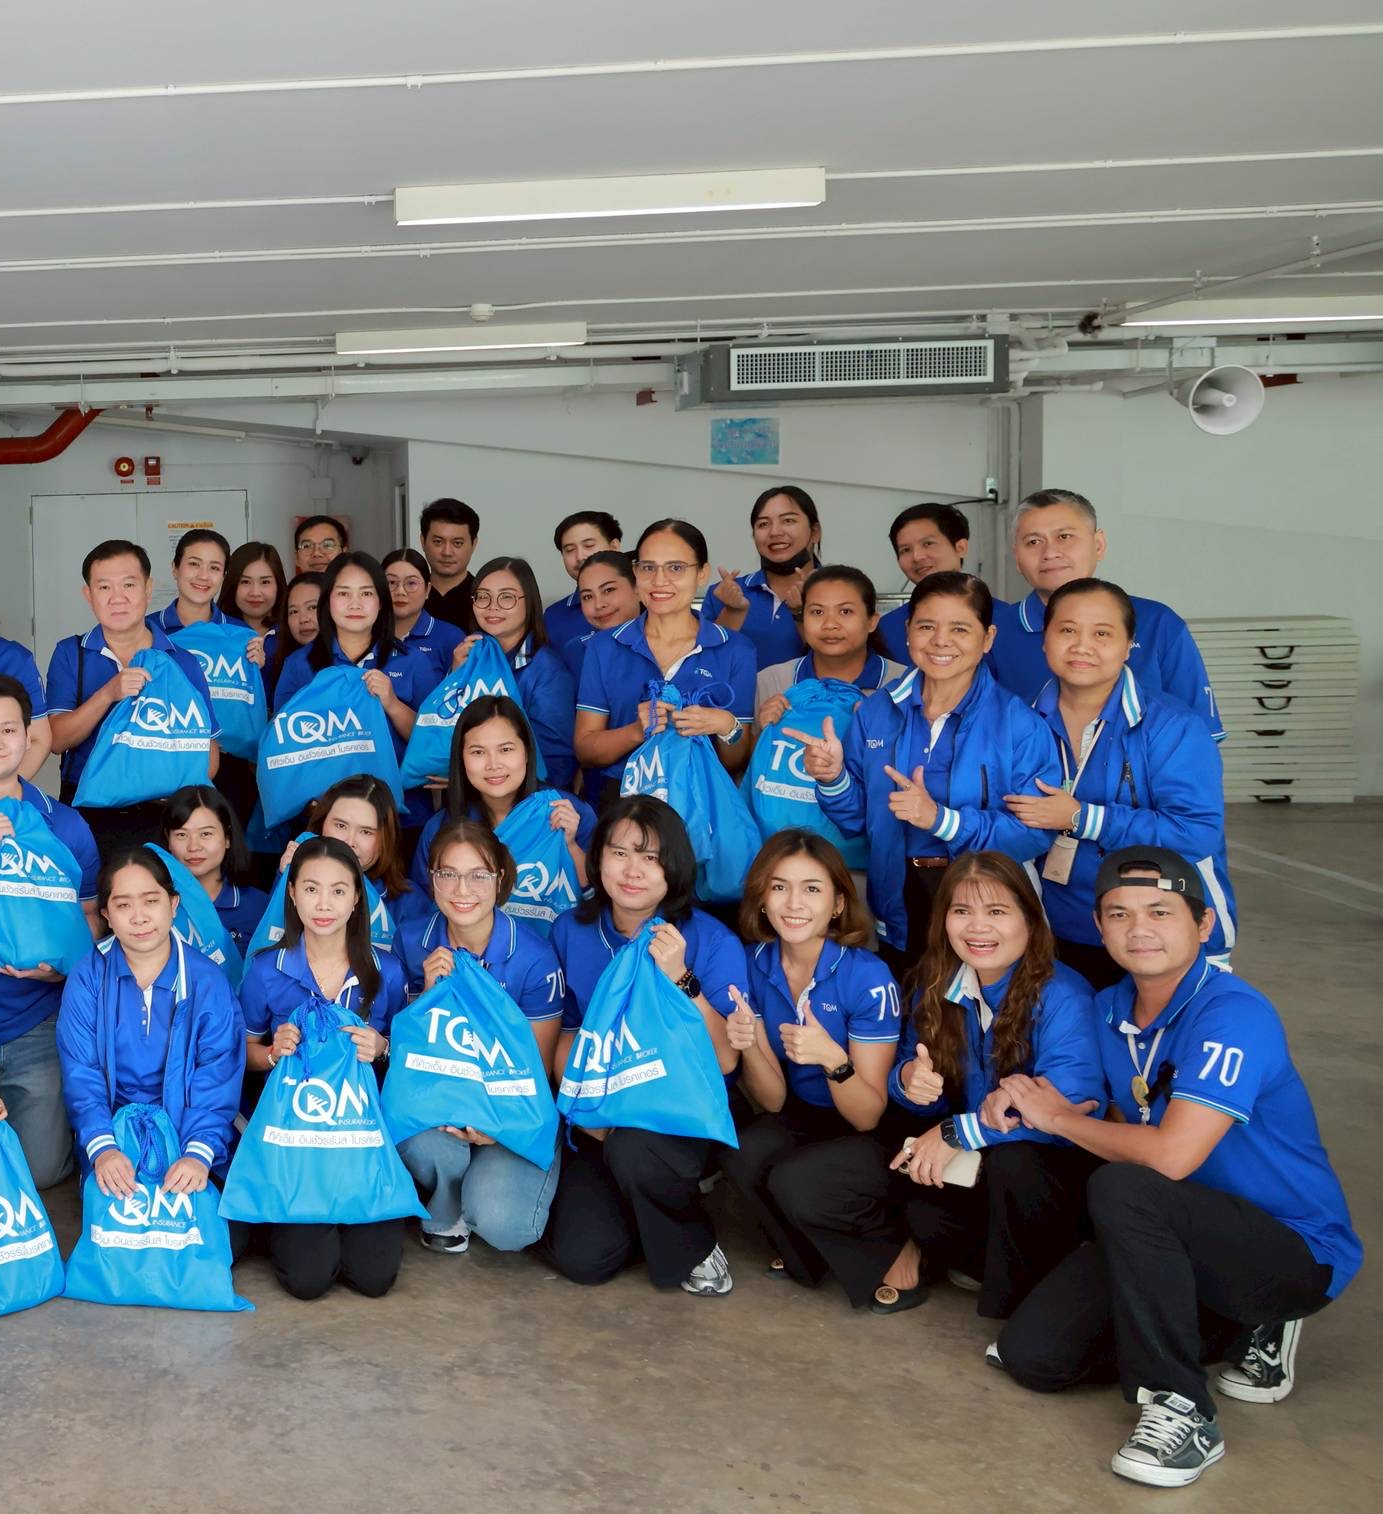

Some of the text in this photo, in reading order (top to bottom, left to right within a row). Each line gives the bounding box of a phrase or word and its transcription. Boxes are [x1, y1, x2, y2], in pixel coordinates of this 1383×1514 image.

[188, 649, 247, 683] QM
[273, 707, 362, 745] TQM
[866, 739, 884, 749] TQM
[513, 861, 576, 902] QM
[546, 968, 566, 1004] 70
[869, 982, 900, 1021] 70
[822, 1002, 838, 1012] TQM
[1198, 1041, 1245, 1087] 70
[107, 1183, 194, 1227] QM
[152, 1219, 186, 1228] INSURANCE
